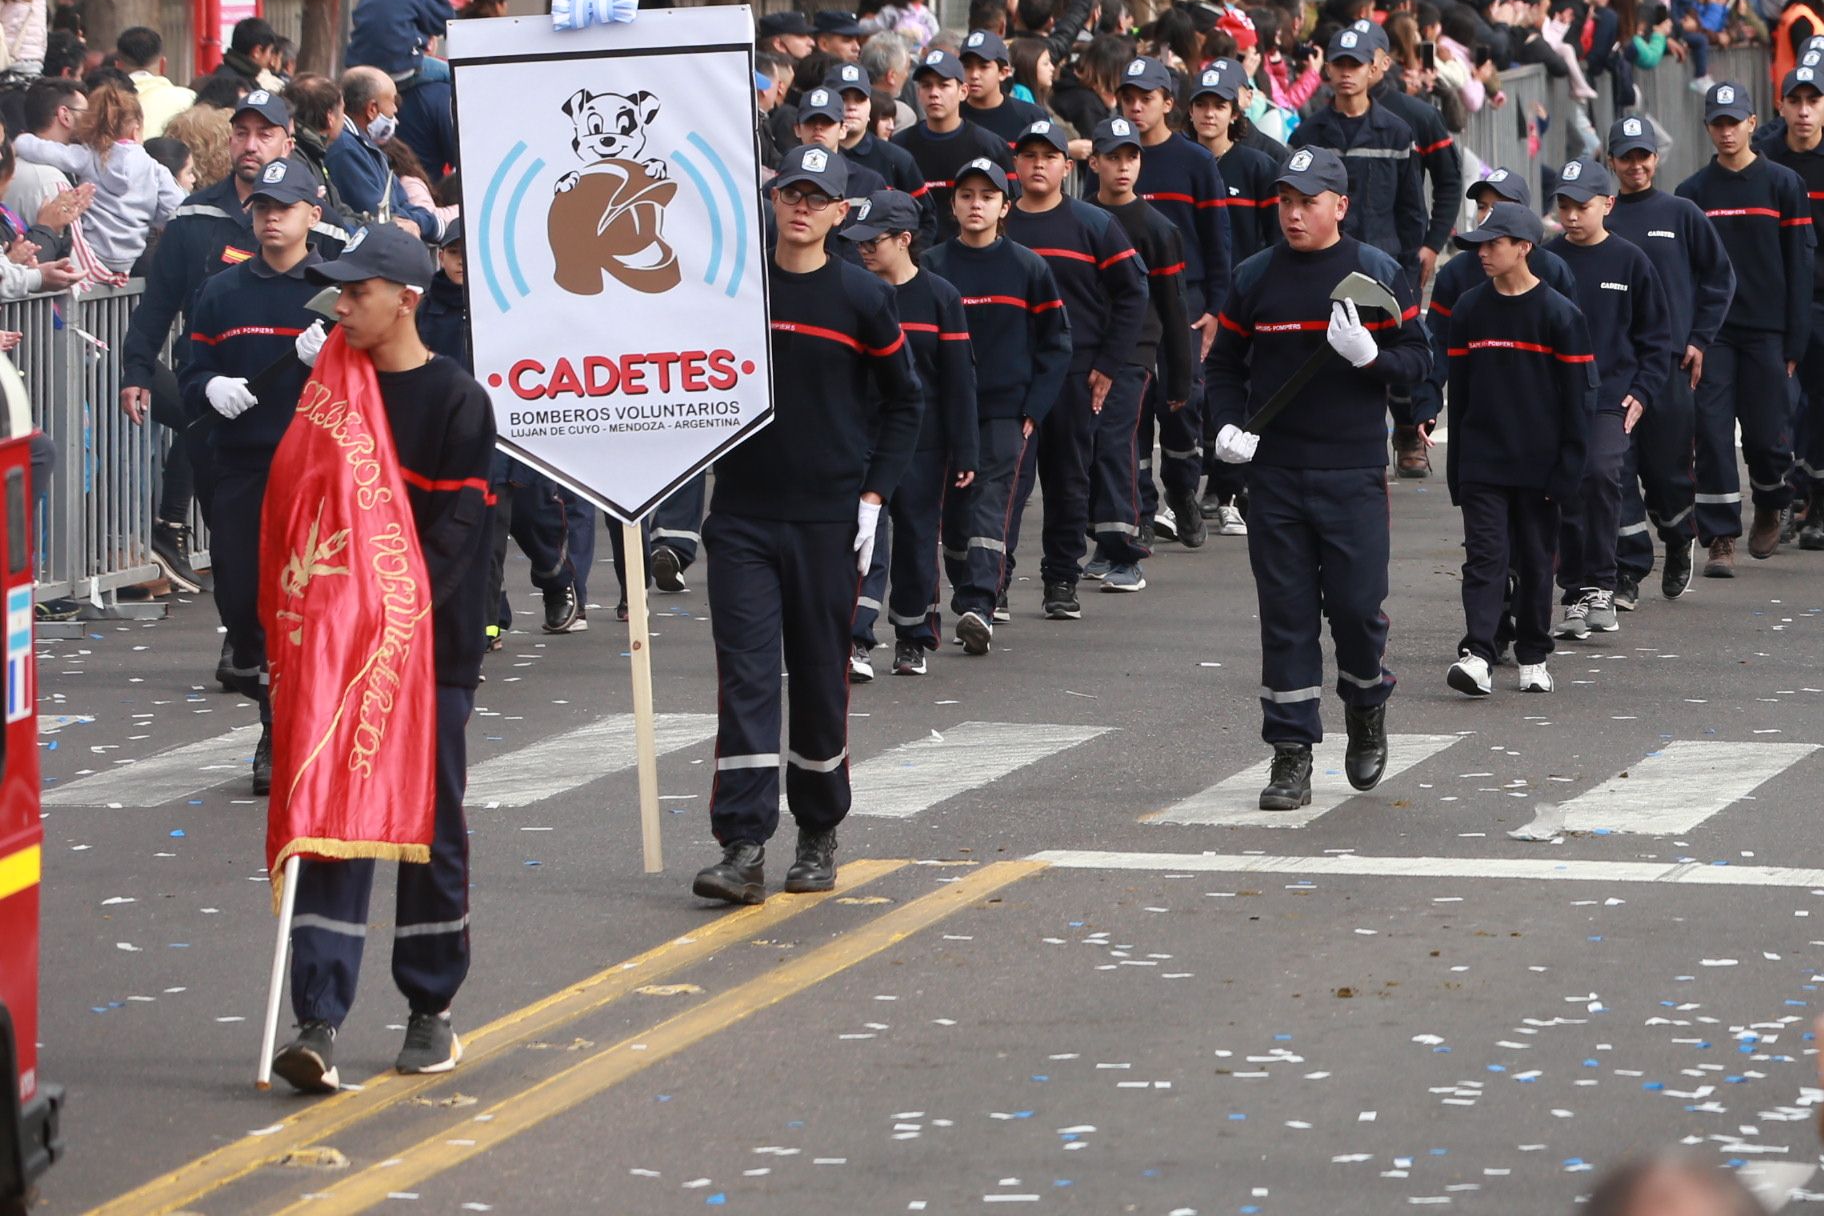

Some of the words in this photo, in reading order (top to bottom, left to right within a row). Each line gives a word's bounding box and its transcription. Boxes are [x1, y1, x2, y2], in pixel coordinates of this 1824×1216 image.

[508, 349, 738, 401] CADETES
[509, 407, 611, 427] BOMBEROS
[614, 400, 741, 421] VOLUNTARIOS
[510, 427, 549, 438] LUJAN
[549, 426, 567, 437] DE
[567, 424, 601, 436] CUYO
[608, 421, 667, 434] MENDOZA
[674, 417, 742, 430] ARGENTINA
